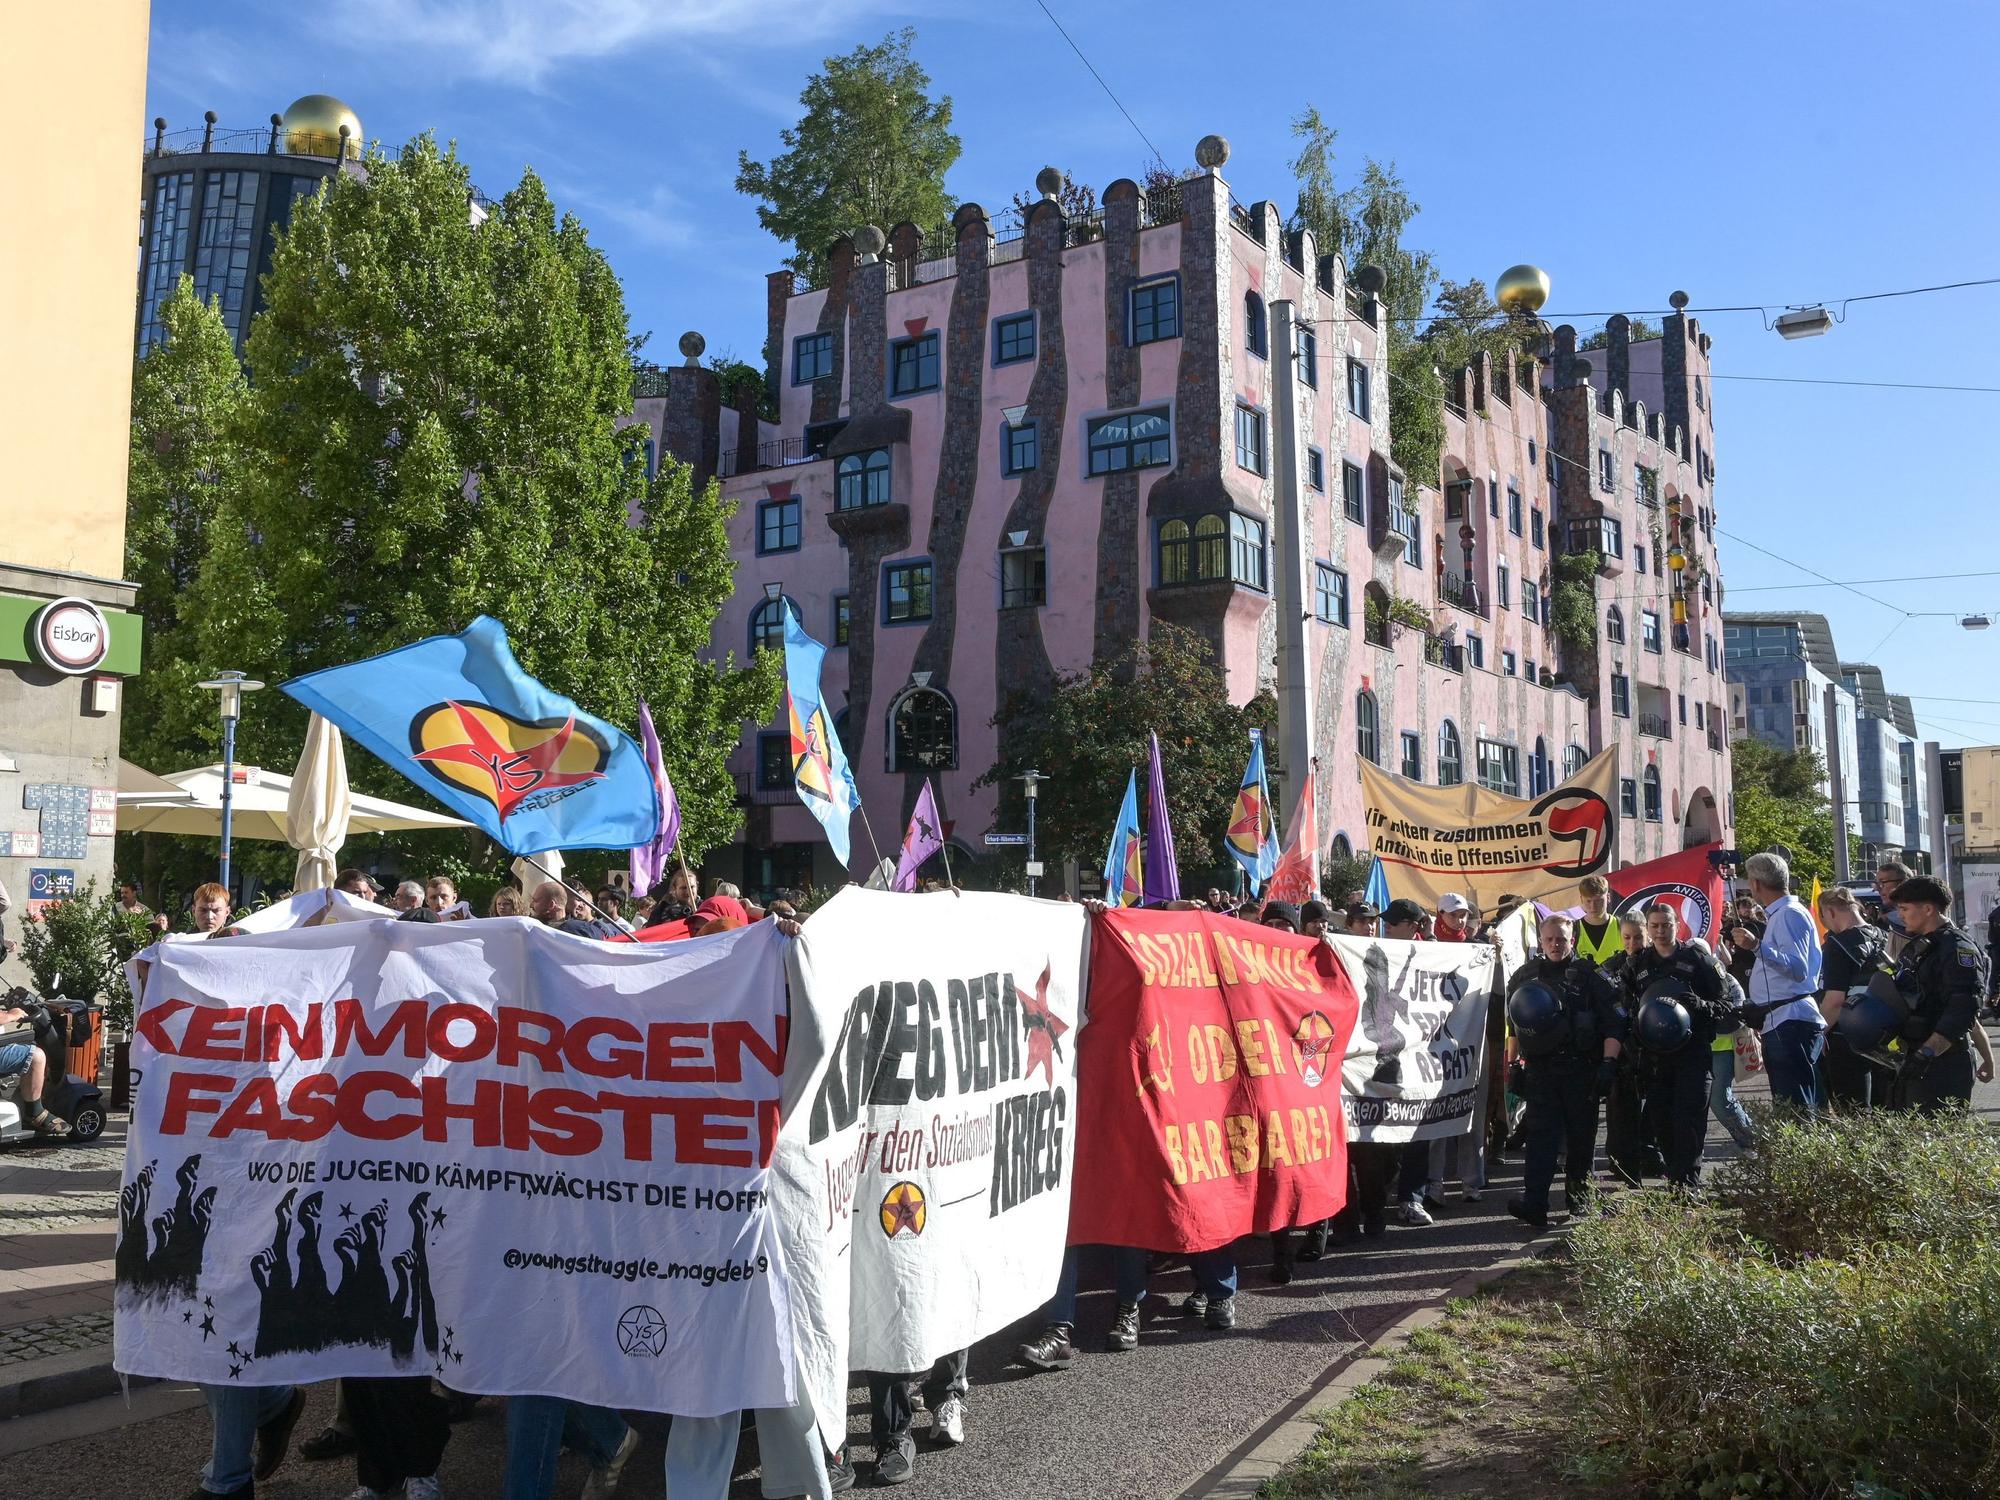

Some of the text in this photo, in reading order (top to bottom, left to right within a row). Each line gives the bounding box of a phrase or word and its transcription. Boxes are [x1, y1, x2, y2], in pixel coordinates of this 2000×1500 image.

[53, 625, 96, 643] Eisbar
[508, 778, 598, 816] STRUGGLE
[1416, 846, 1428, 865] in
[1431, 849, 1453, 867] die
[1458, 843, 1548, 867] Offensive!
[1433, 821, 1543, 843] zusammen
[1122, 930, 1323, 994] SOZIALISMUS
[136, 998, 787, 1084] KEIN MORGEN
[948, 972, 1020, 1094] DEM
[1188, 1018, 1287, 1085] ODER
[881, 1120, 923, 1175] den
[927, 1103, 993, 1169] Sozialismus!
[1165, 1104, 1331, 1185] BARBAREI
[1343, 1100, 1379, 1126] egen
[989, 1085, 1067, 1219] KRIEG
[248, 1161, 283, 1184] WO
[287, 1161, 316, 1184] DIE
[322, 1160, 430, 1184] JUGEND
[528, 1171, 638, 1203] WÄCHST
[645, 1184, 686, 1209] DIE
